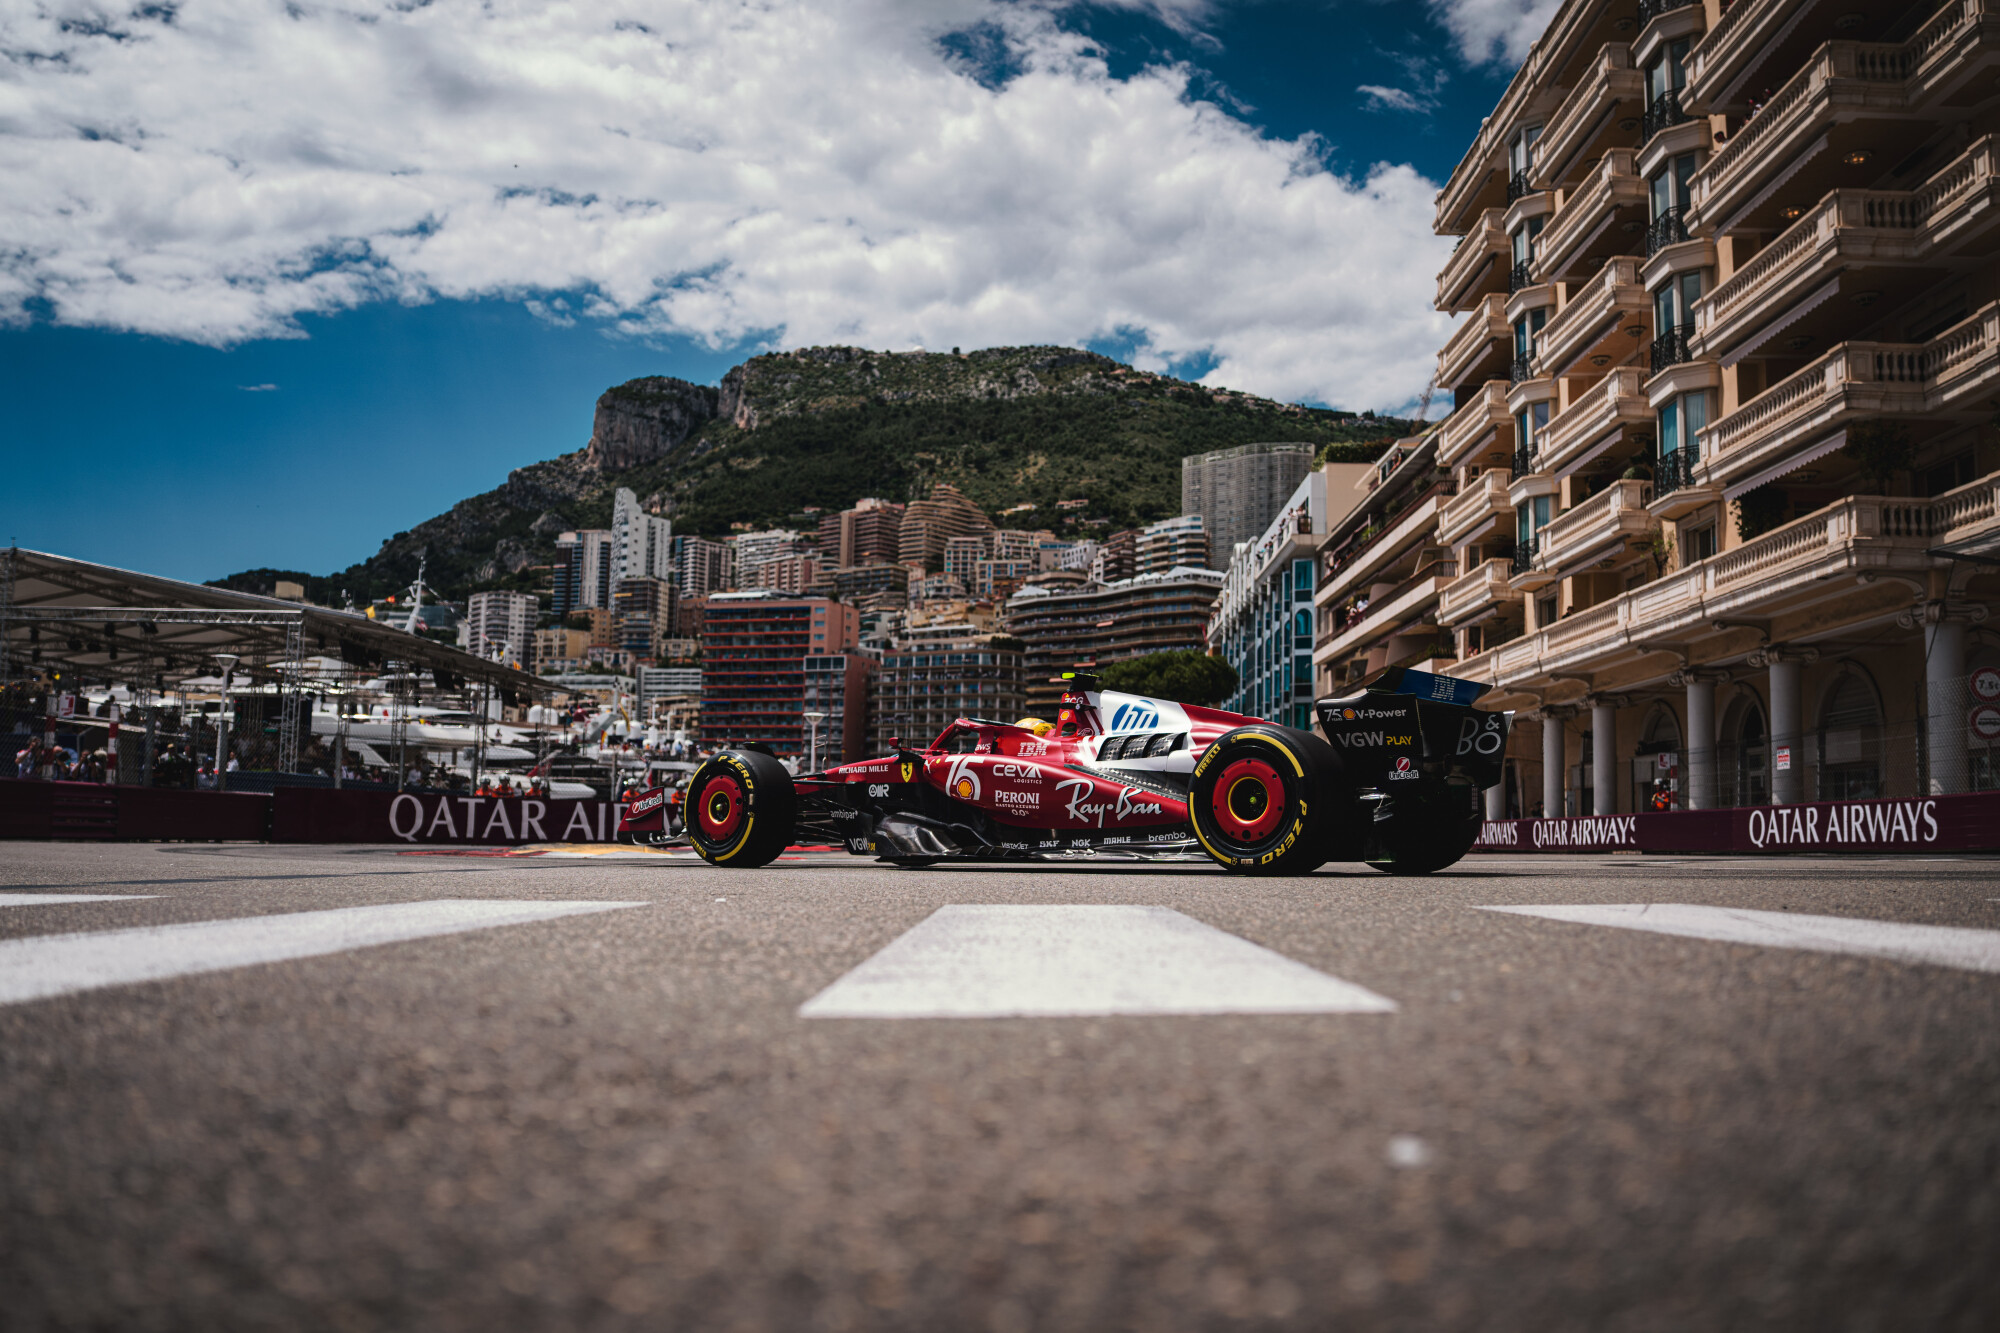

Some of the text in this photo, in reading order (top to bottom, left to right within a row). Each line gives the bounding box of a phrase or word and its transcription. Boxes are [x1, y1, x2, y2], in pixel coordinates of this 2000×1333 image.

[1355, 708, 1407, 720] V-Power
[1336, 731, 1412, 748] VGW PLAY
[1017, 742, 1051, 757] IBM
[838, 764, 889, 774] RICHARD MILLE
[1389, 769, 1420, 780] UniCredit
[639, 793, 663, 811] UniCredit
[995, 789, 1040, 804] PERONI
[388, 794, 548, 842] QATAR
[1749, 800, 1939, 848] QATAR AIRWAYS
[1103, 835, 1132, 845] MAHLE
[1148, 831, 1187, 842] brembo
[1481, 821, 1518, 845] AIRWAYS
[1532, 820, 1568, 848] QATAR
[849, 837, 869, 851] VGW
[1039, 840, 1060, 848] SKF
[1071, 839, 1091, 848] NGK
